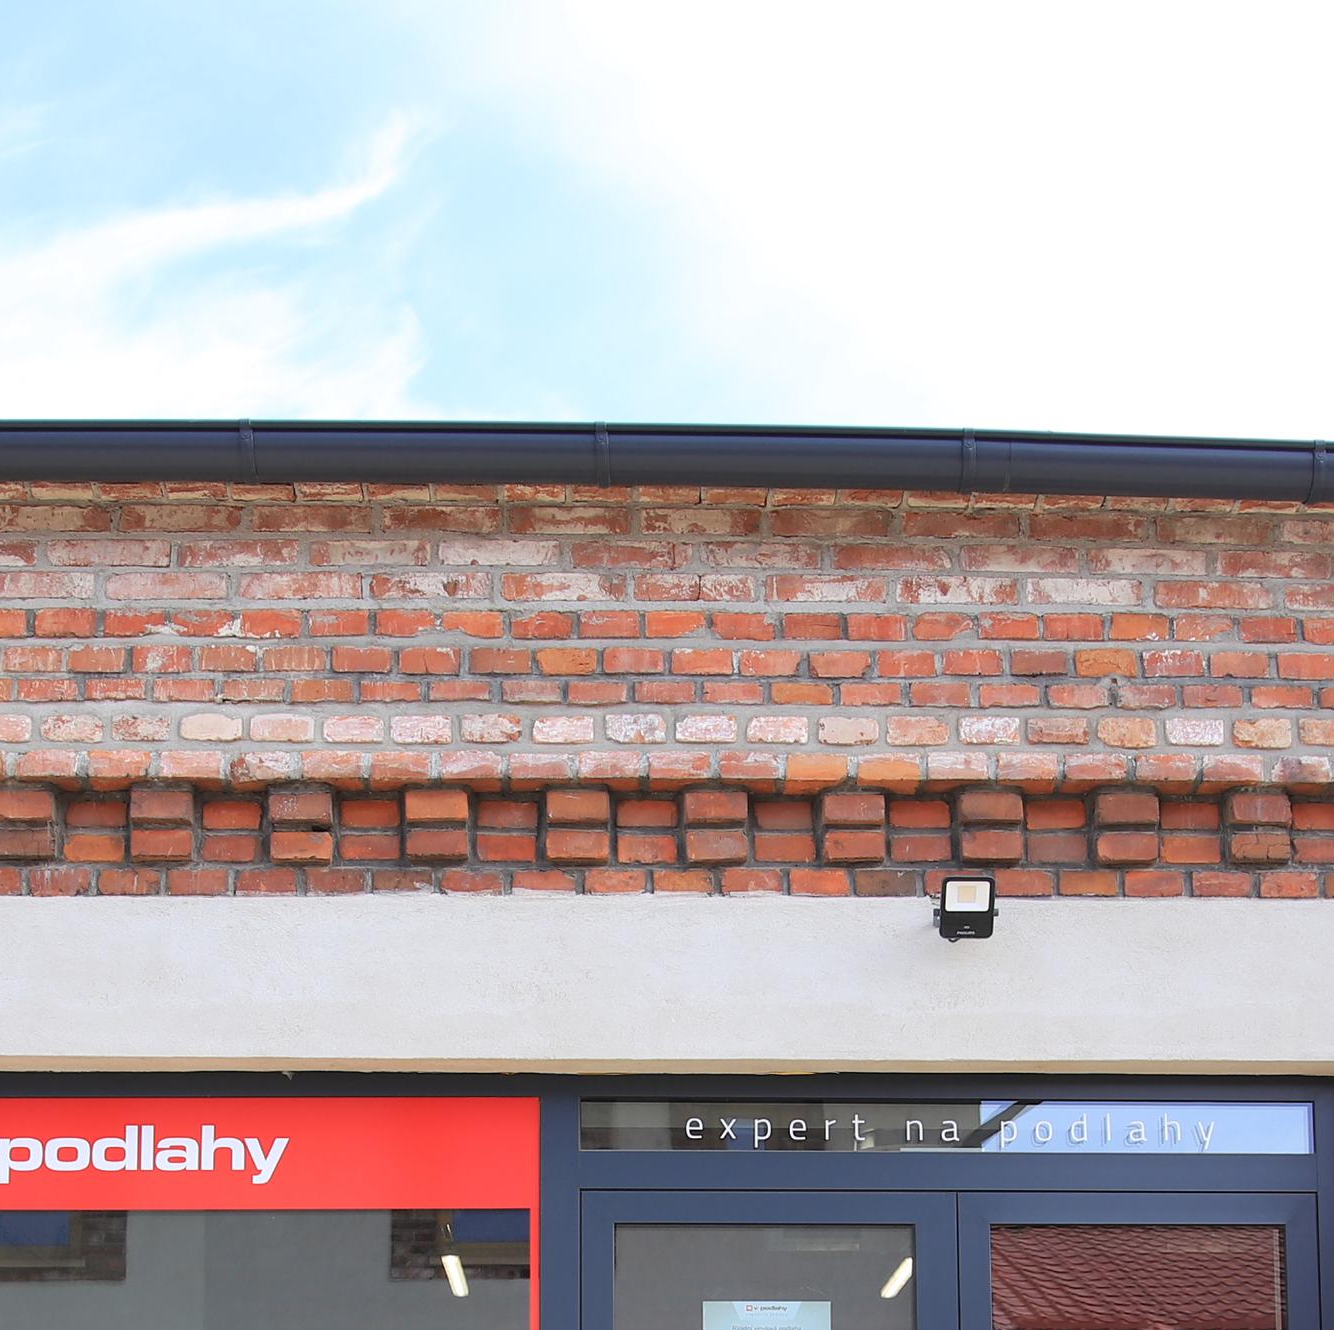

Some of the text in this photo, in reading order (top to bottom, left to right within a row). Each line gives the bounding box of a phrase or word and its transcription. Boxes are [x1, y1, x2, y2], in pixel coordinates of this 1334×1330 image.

[685, 1113, 1216, 1151] expert na podlahy
